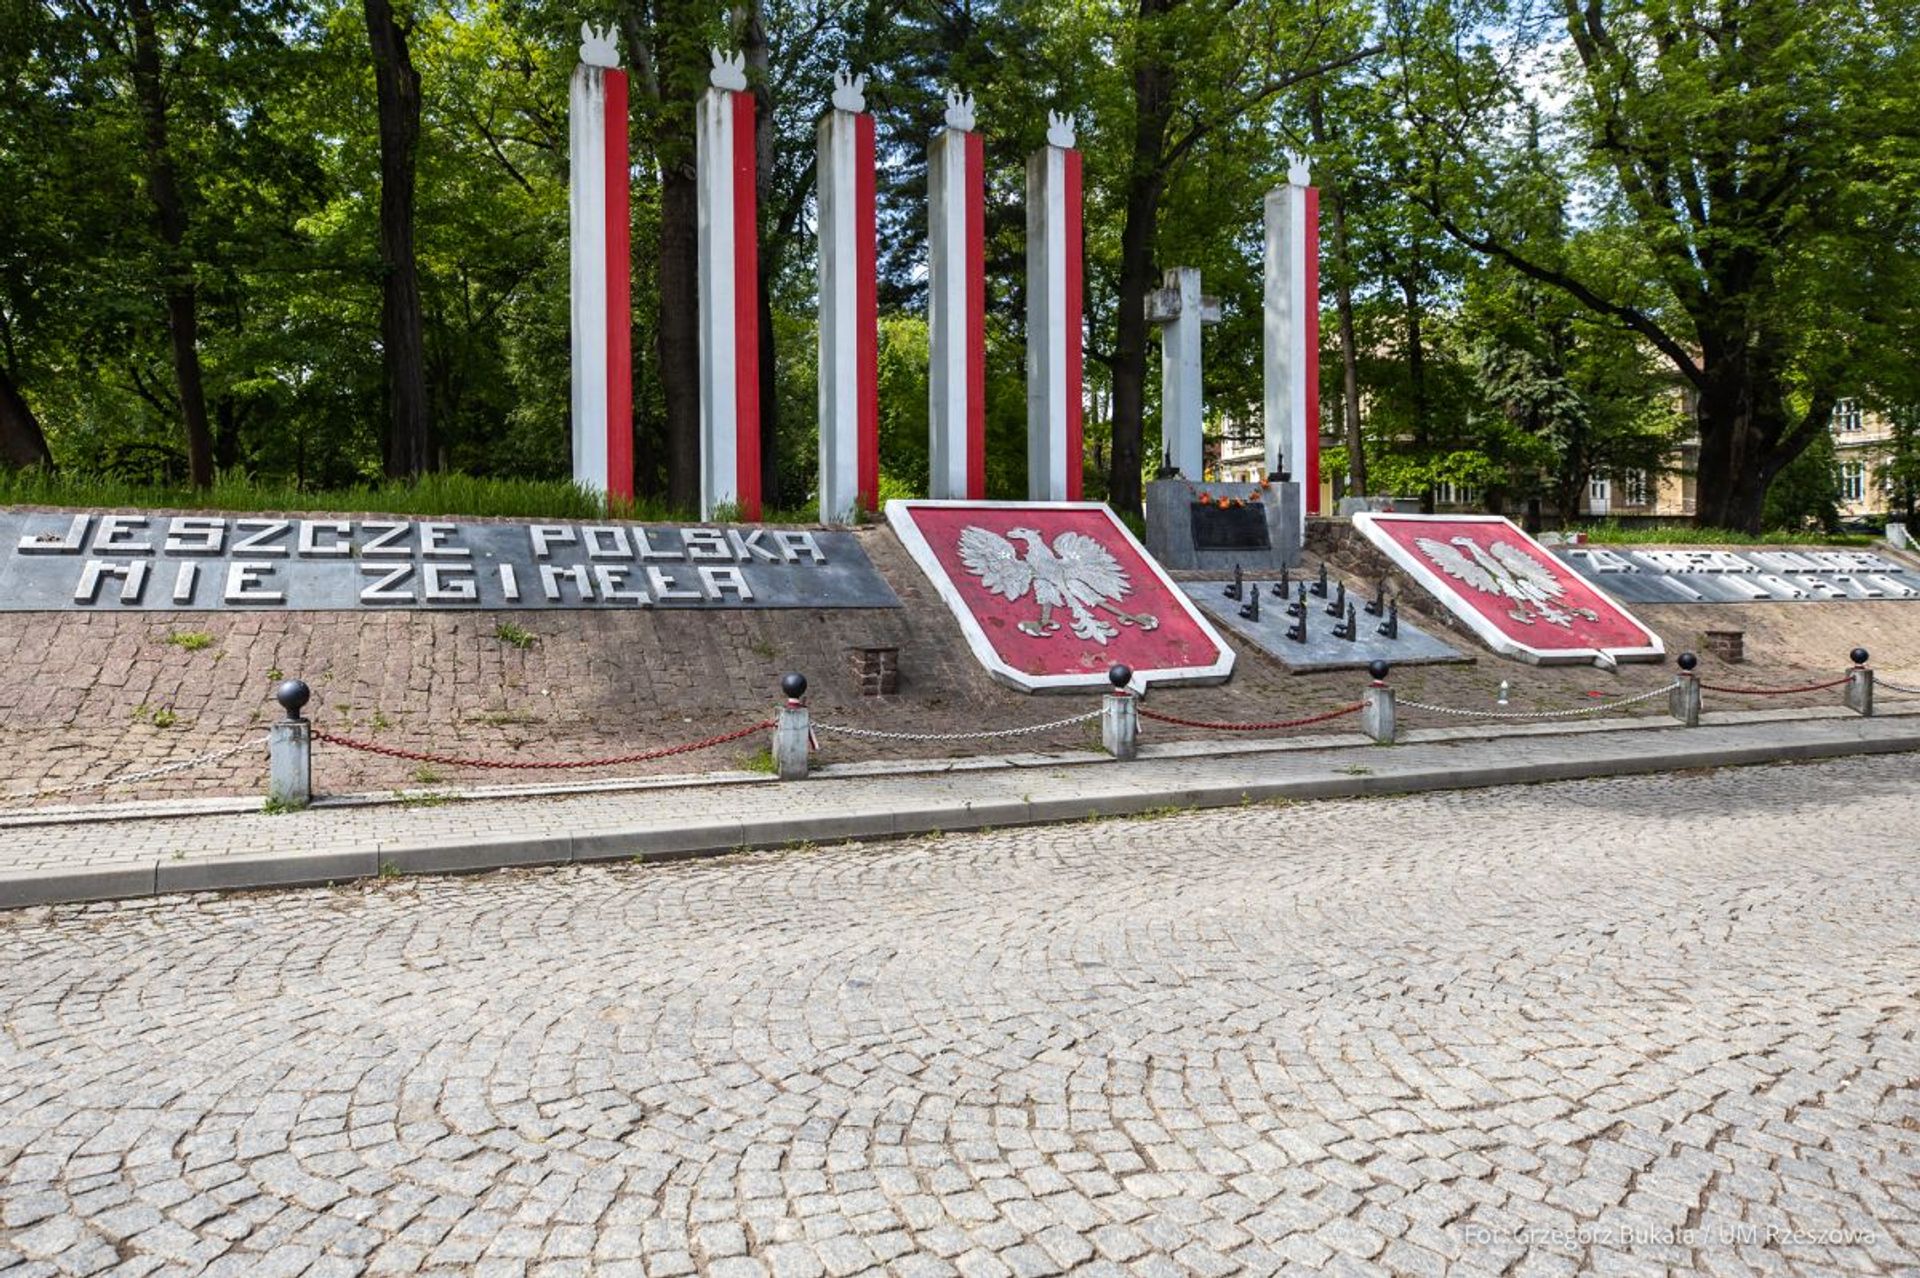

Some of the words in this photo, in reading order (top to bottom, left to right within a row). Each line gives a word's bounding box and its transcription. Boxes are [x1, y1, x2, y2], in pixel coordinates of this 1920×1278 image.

[18, 514, 472, 557] JESZCZE
[530, 524, 827, 564] POLSKA
[74, 560, 286, 604] NIE
[360, 562, 754, 606] ZGINĘŁA
